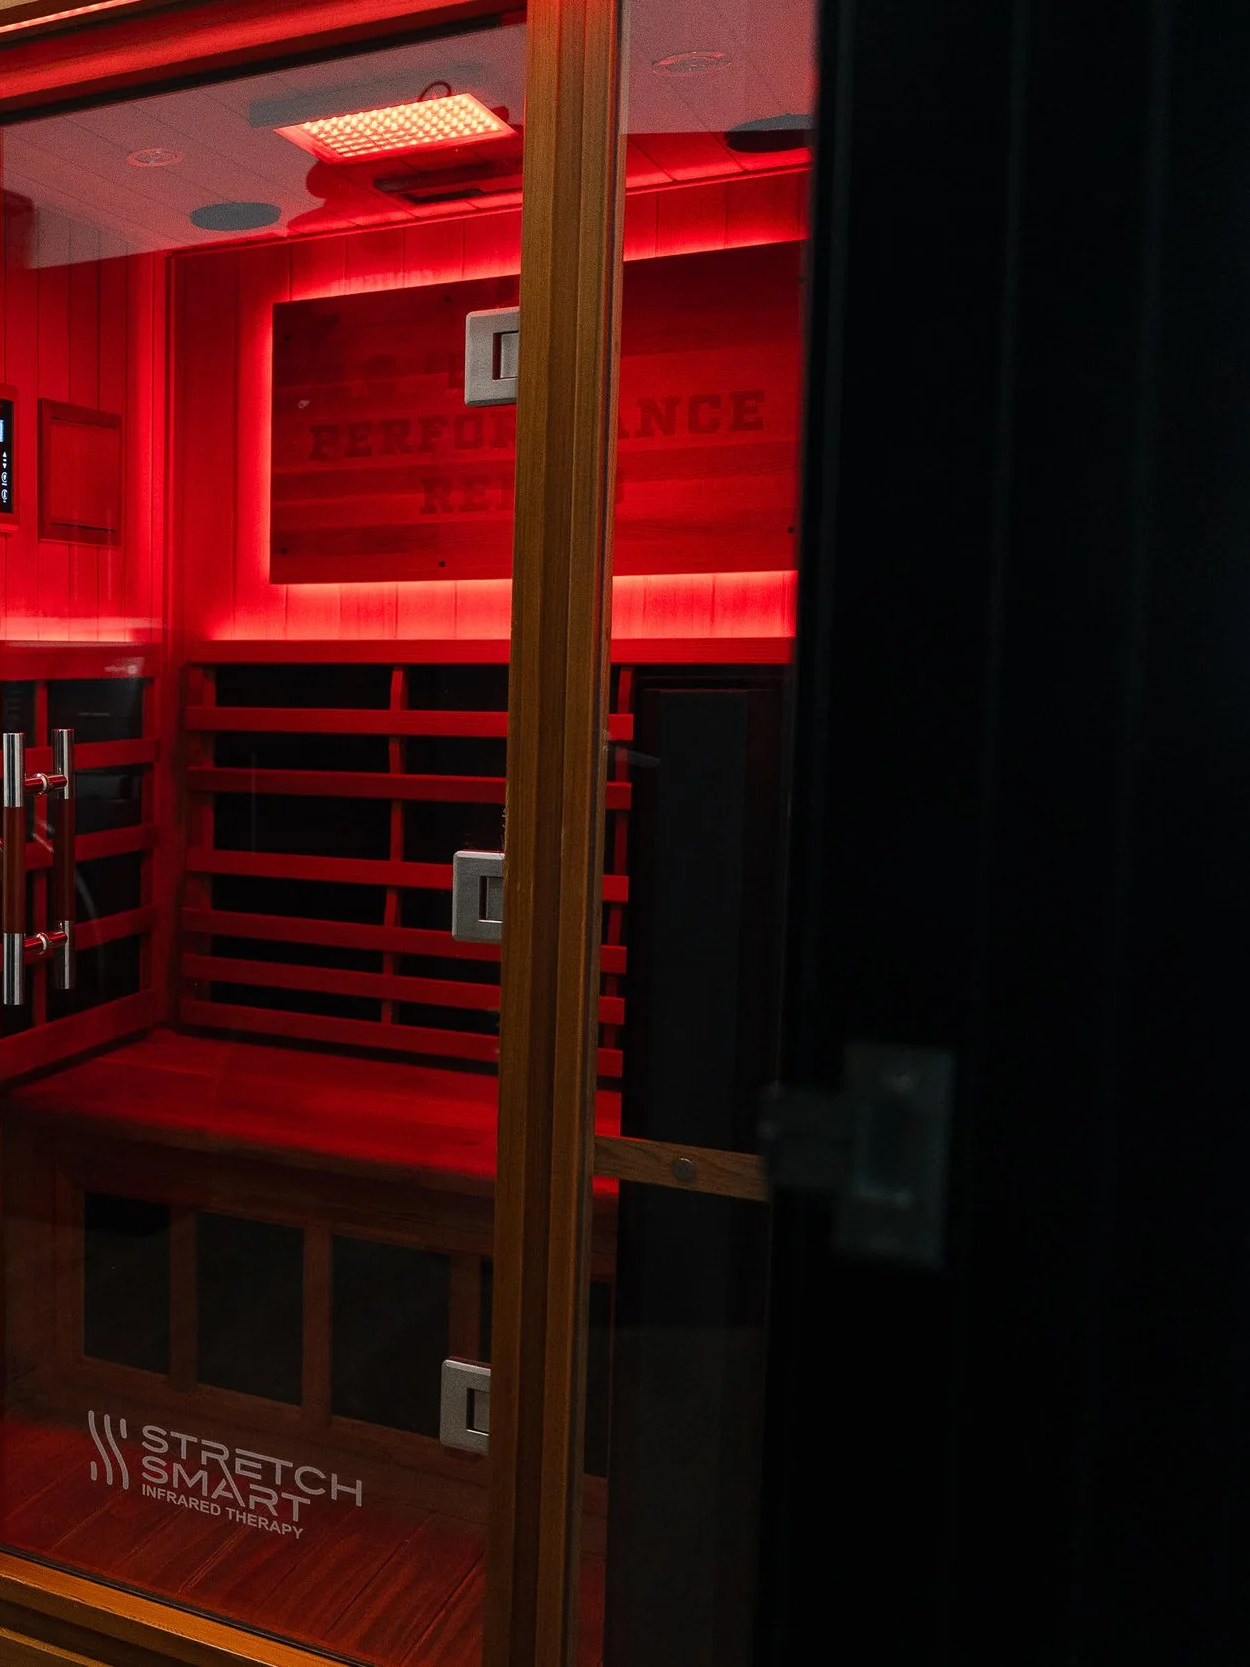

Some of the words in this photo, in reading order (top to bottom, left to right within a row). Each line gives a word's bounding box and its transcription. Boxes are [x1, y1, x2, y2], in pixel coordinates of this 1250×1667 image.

[142, 1425, 362, 1507] STRETCH
[142, 1456, 310, 1522] SMART
[142, 1483, 221, 1517] INFRARED
[226, 1507, 304, 1539] THERAPY
